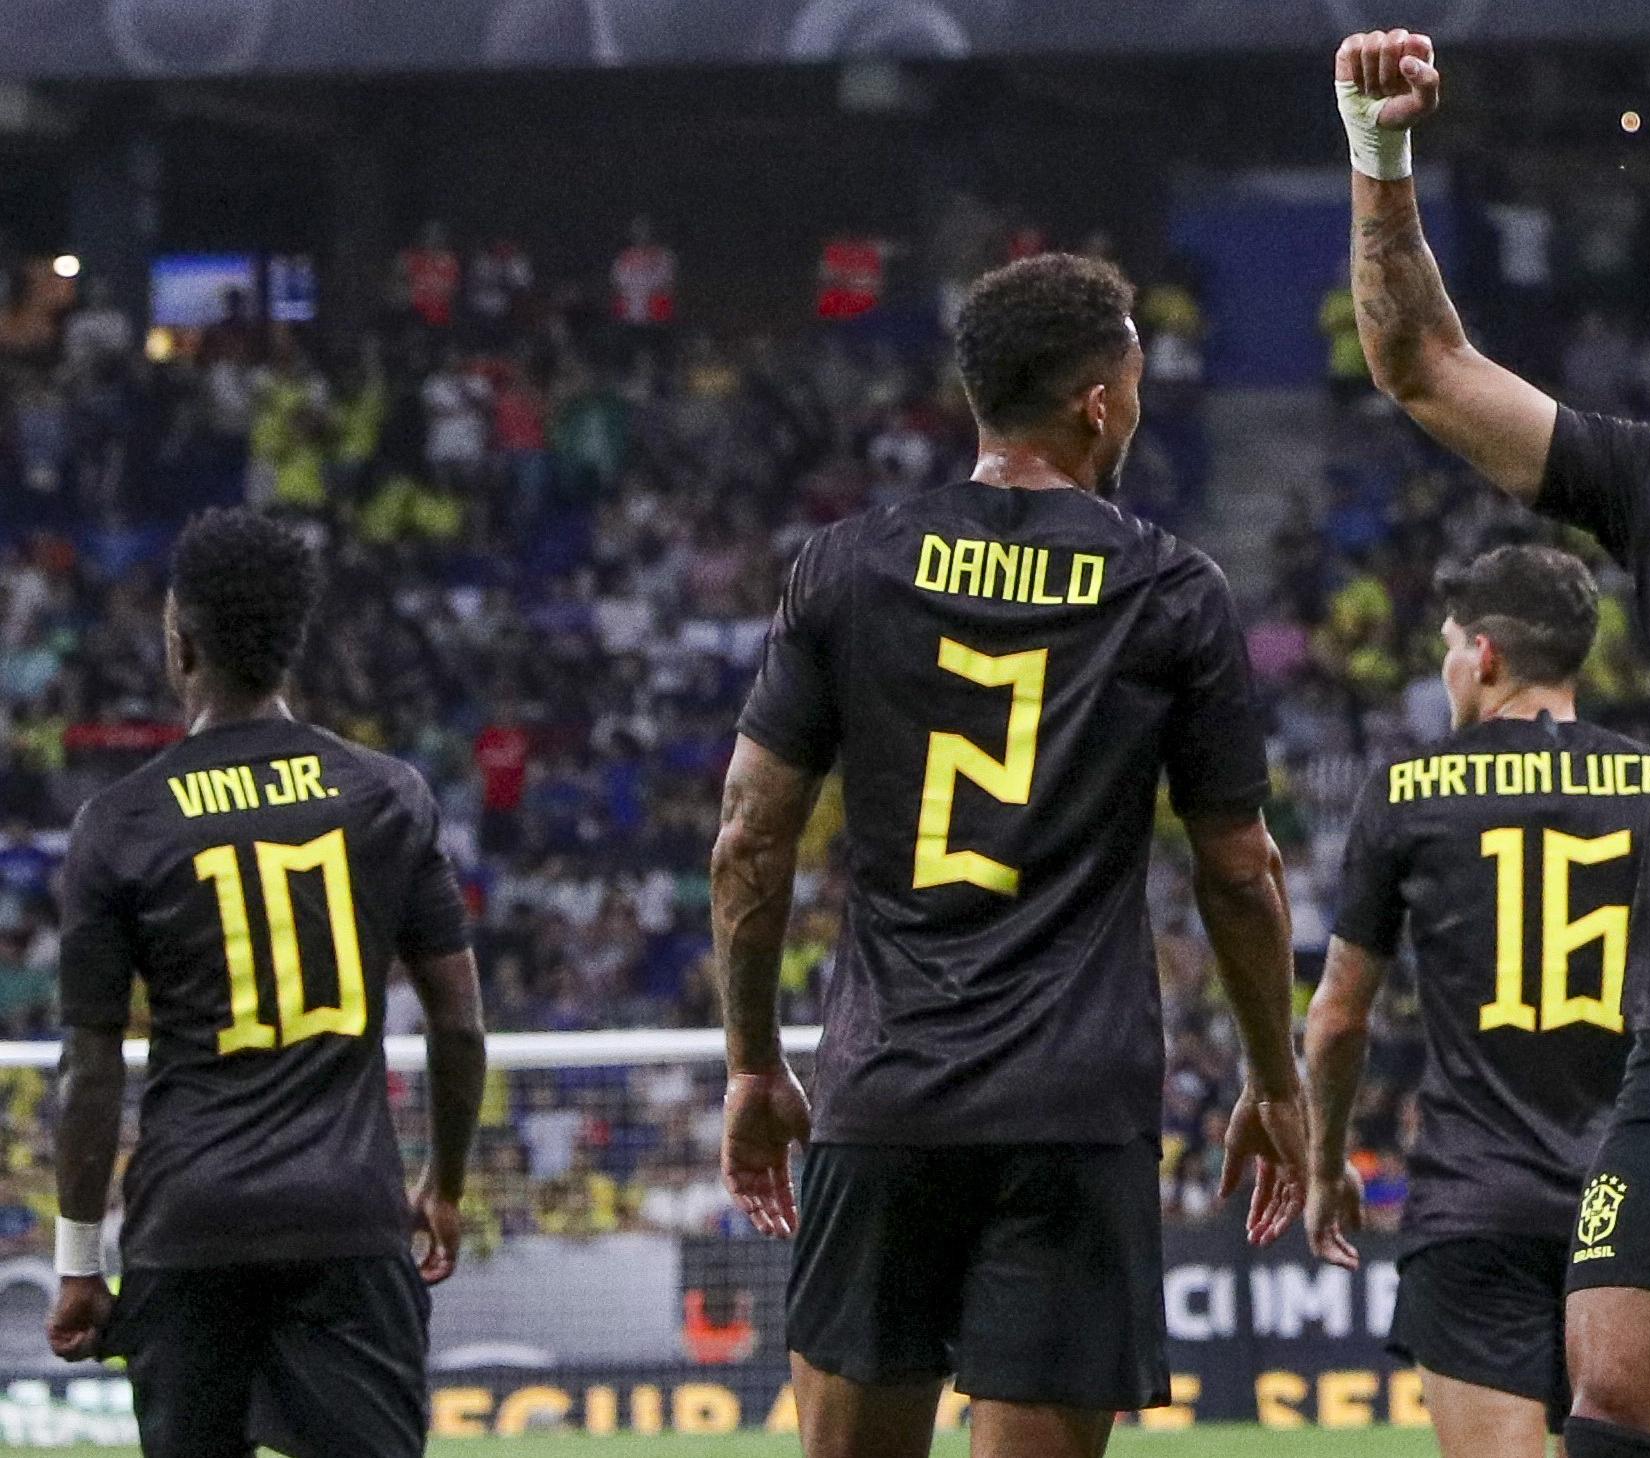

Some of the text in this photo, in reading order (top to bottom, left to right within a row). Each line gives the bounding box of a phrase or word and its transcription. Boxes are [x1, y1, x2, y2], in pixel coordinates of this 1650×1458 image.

[914, 534, 1105, 605] DANILO
[167, 754, 340, 818] VINI JR.
[912, 636, 1049, 897] 2
[1389, 751, 1553, 804] AYRTON
[192, 827, 368, 1056] 10
[1478, 827, 1633, 1034] 16
[1573, 1245, 1616, 1264] BRASIL
